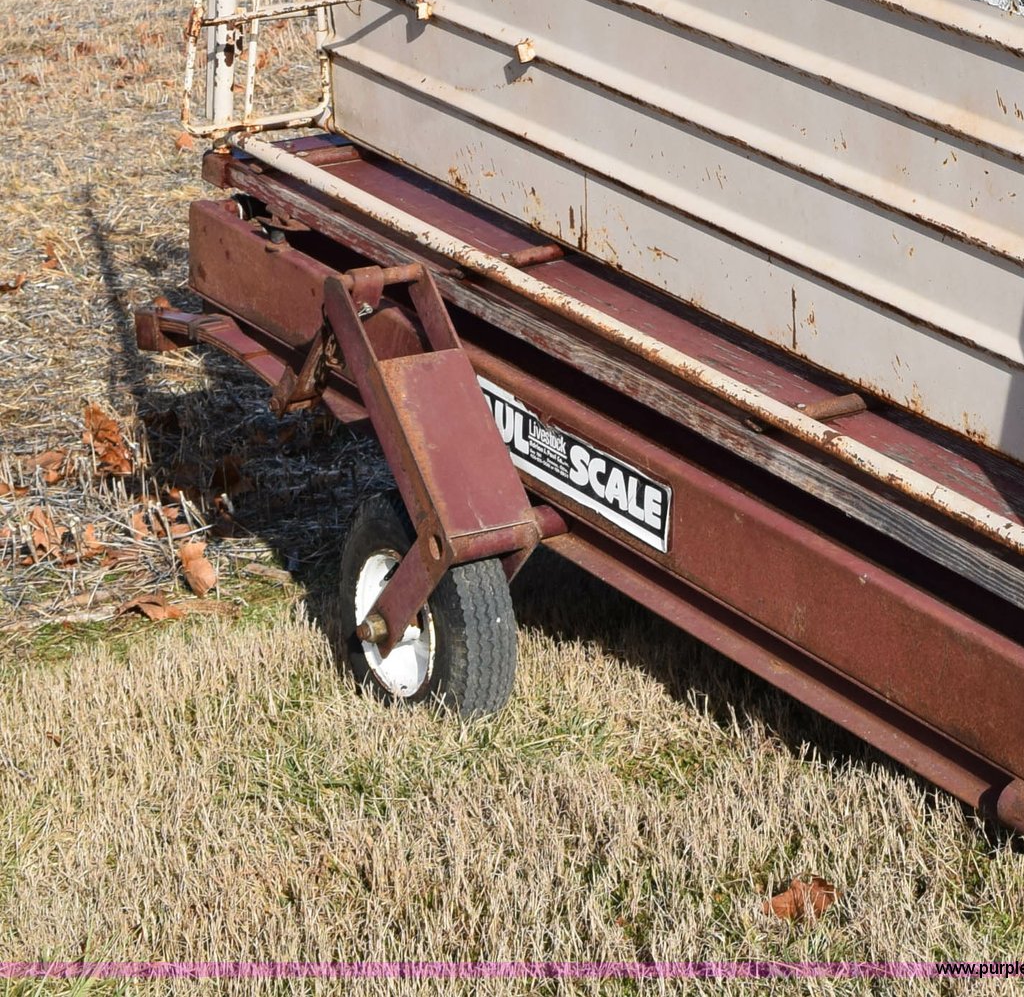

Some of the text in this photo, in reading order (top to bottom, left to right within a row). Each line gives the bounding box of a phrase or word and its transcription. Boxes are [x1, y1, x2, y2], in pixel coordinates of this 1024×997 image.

[483, 392, 529, 455] UL
[529, 419, 566, 454] Livestock
[569, 444, 662, 530] SCALE
